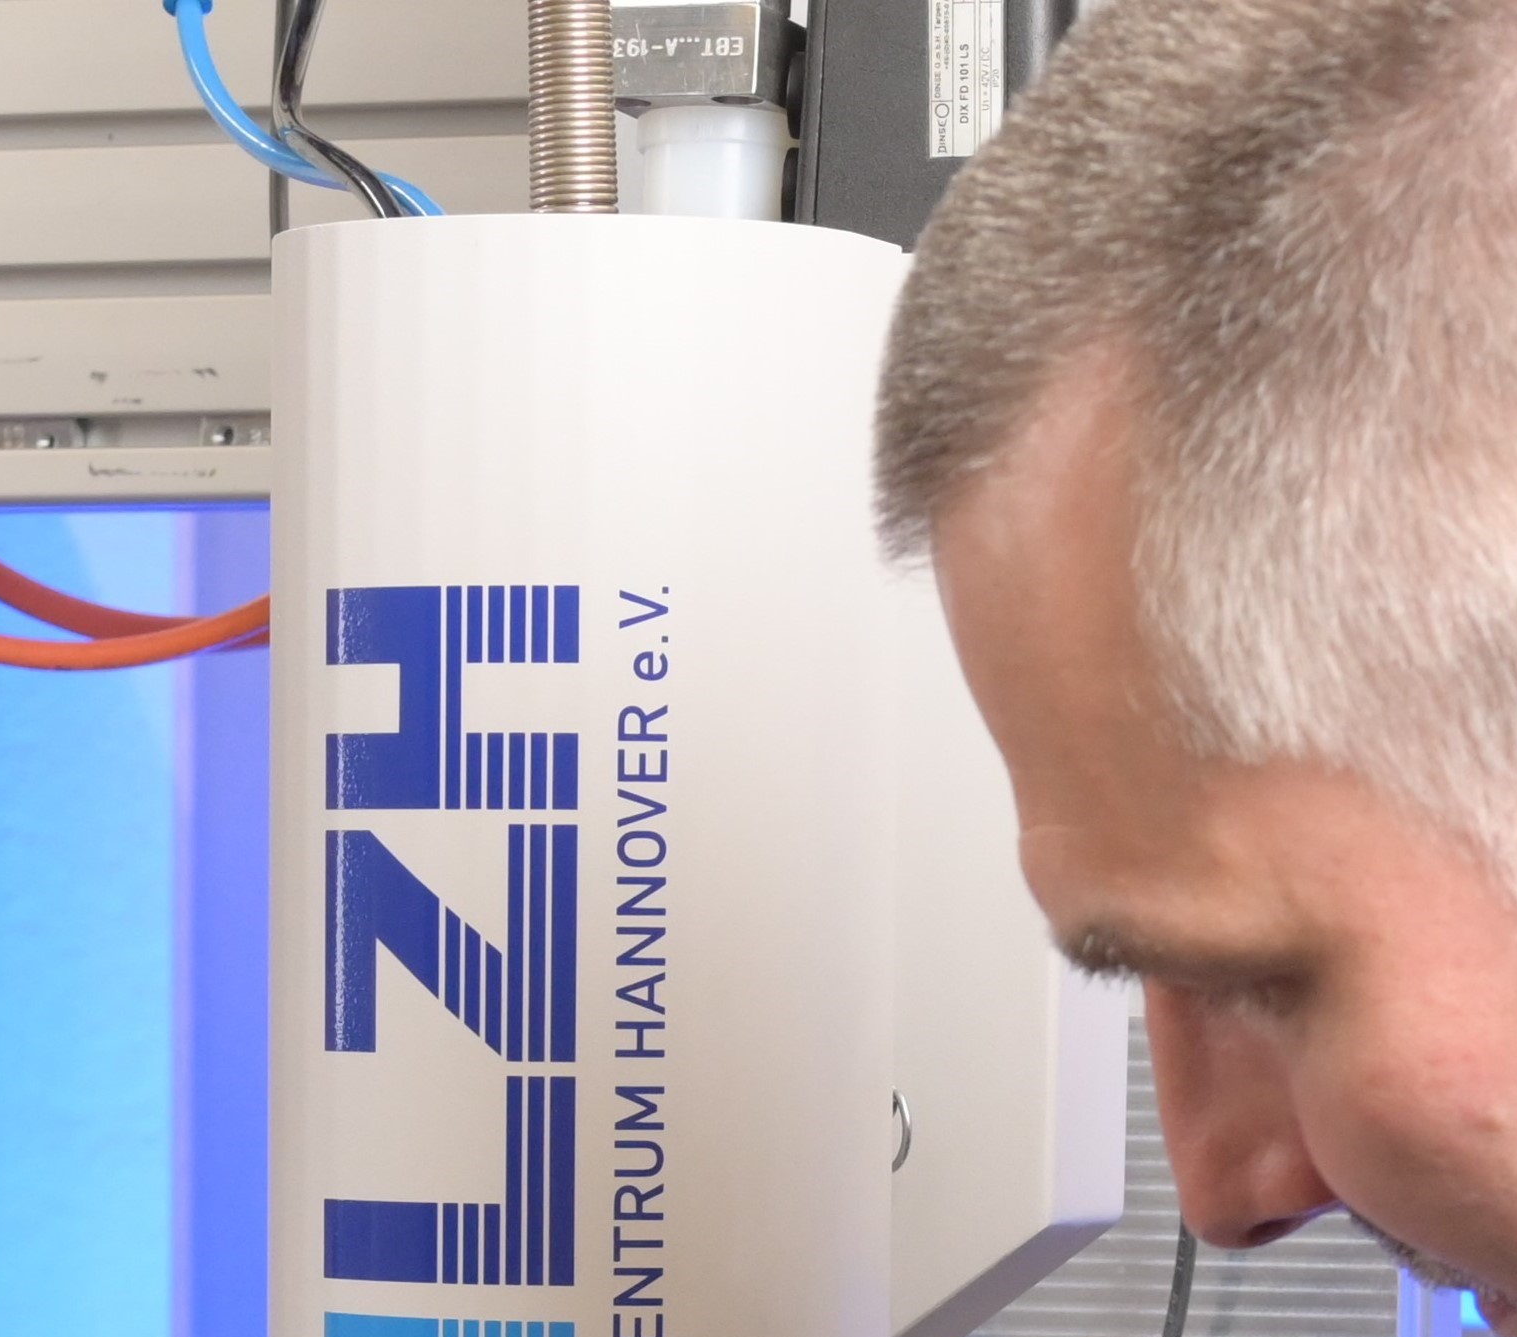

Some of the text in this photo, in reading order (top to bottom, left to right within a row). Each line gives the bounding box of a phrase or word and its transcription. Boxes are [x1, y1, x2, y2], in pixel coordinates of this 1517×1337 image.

[959, 43, 970, 124] DIX FD 101 LS
[619, 584, 670, 681] e.V.
[323, 584, 579, 1287] LZH
[614, 705, 668, 1059] HANNOVER
